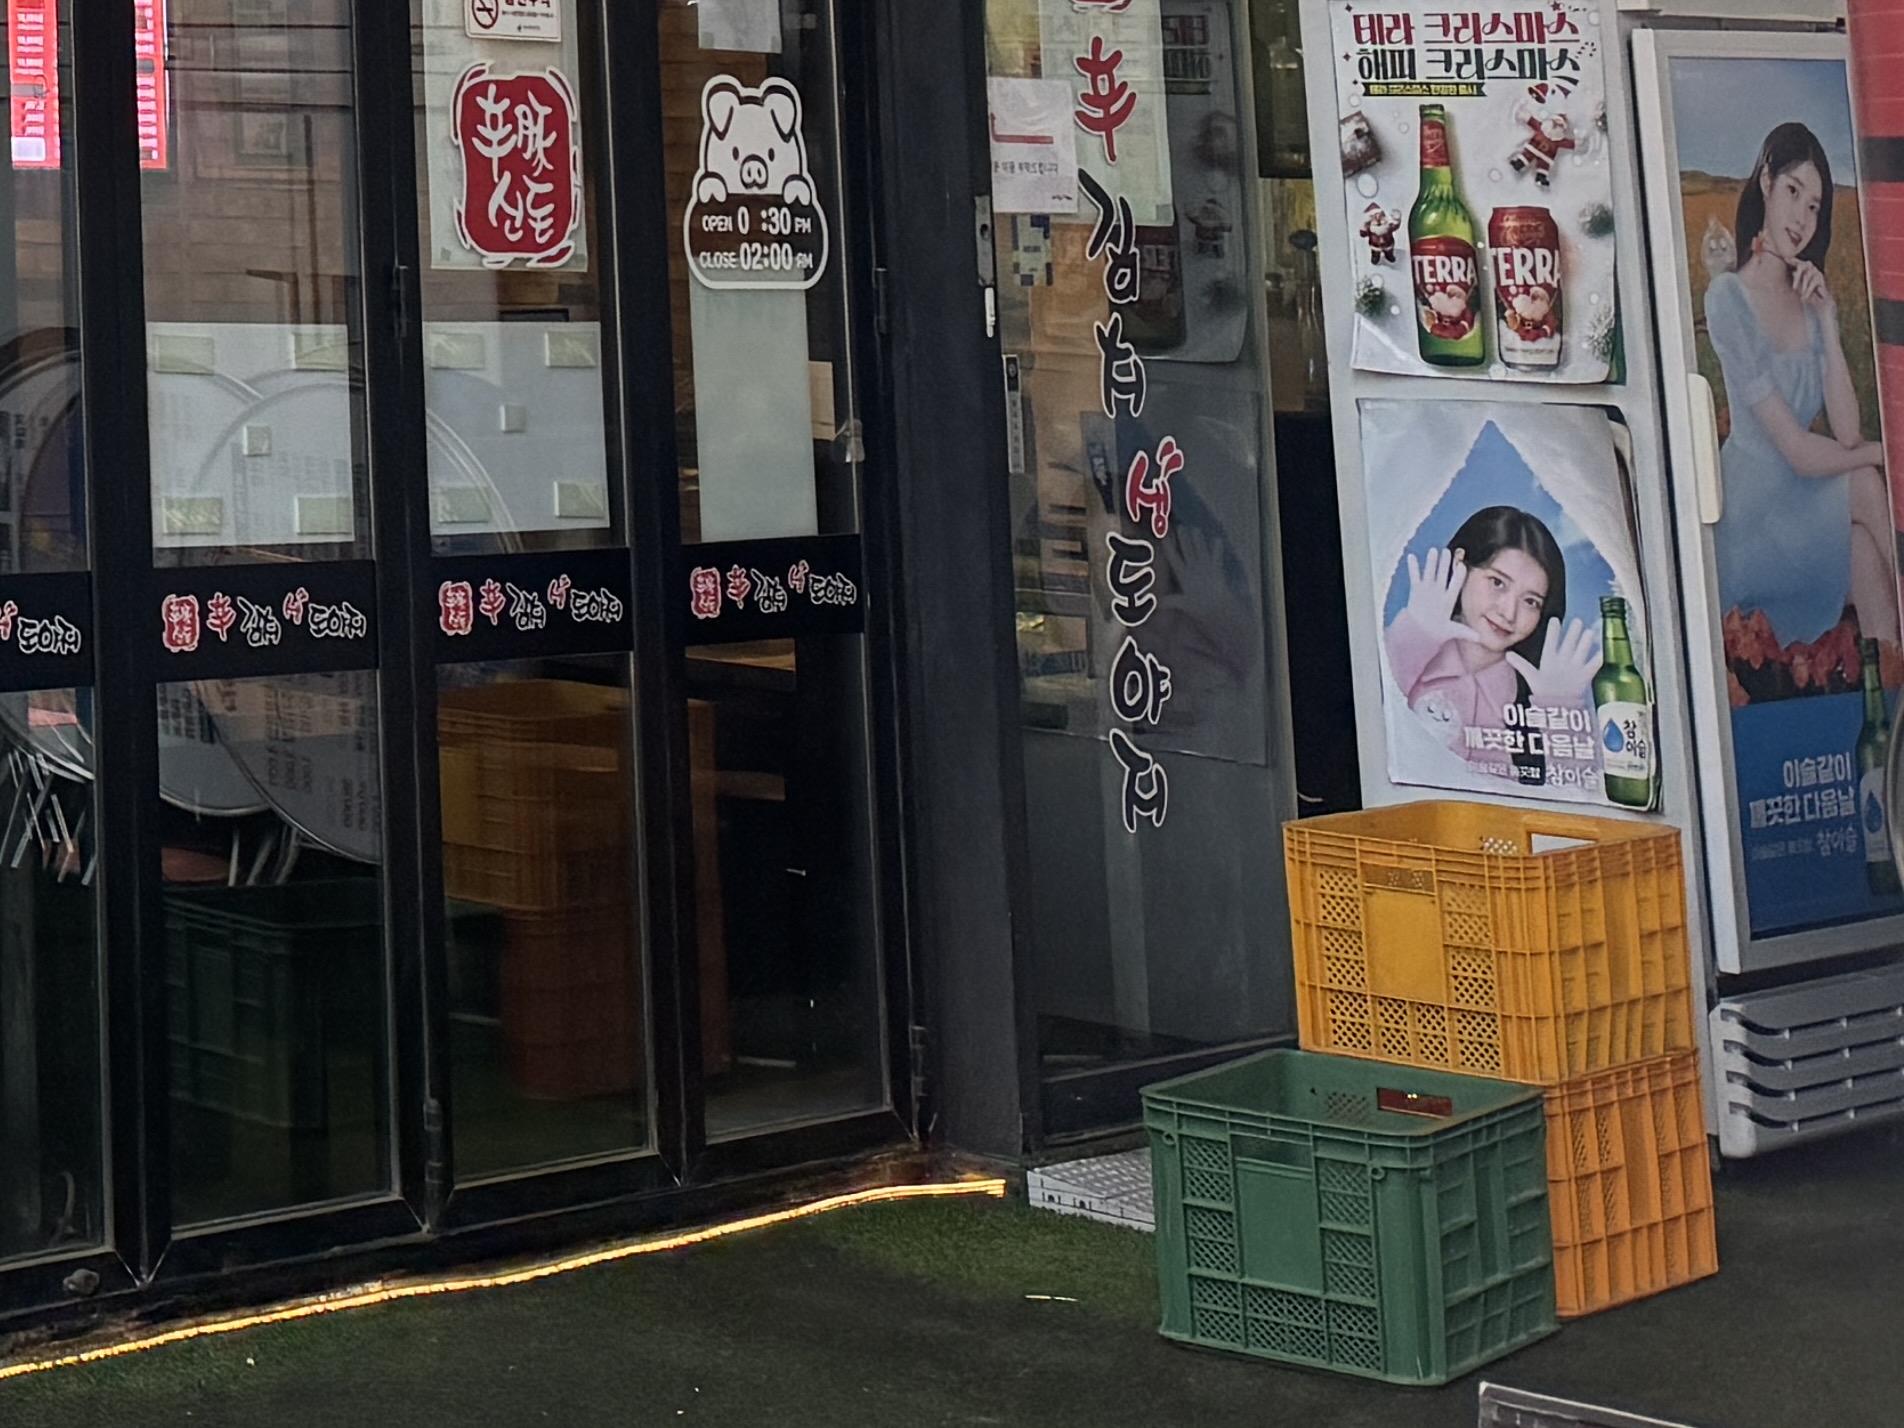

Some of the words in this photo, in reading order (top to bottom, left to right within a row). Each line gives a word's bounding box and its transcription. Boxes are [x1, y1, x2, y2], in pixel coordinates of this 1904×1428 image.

[1353, 12, 1415, 46] 테라
[1423, 11, 1581, 45] 크리스마스
[1355, 47, 1417, 81] 해피
[1425, 47, 1581, 81] 크리스마스
[702, 215, 733, 232] OPEN
[794, 217, 812, 233] PM
[699, 251, 738, 269] CLOSE
[739, 242, 793, 271] 02:00
[1412, 254, 1477, 285] TERRA
[1503, 703, 1591, 733] 이슬같이
[1528, 732, 1596, 760] 다음날
[1545, 764, 1599, 789] 참이슬
[1783, 751, 1852, 788] 이슬같이
[1803, 785, 1856, 820] 다음날
